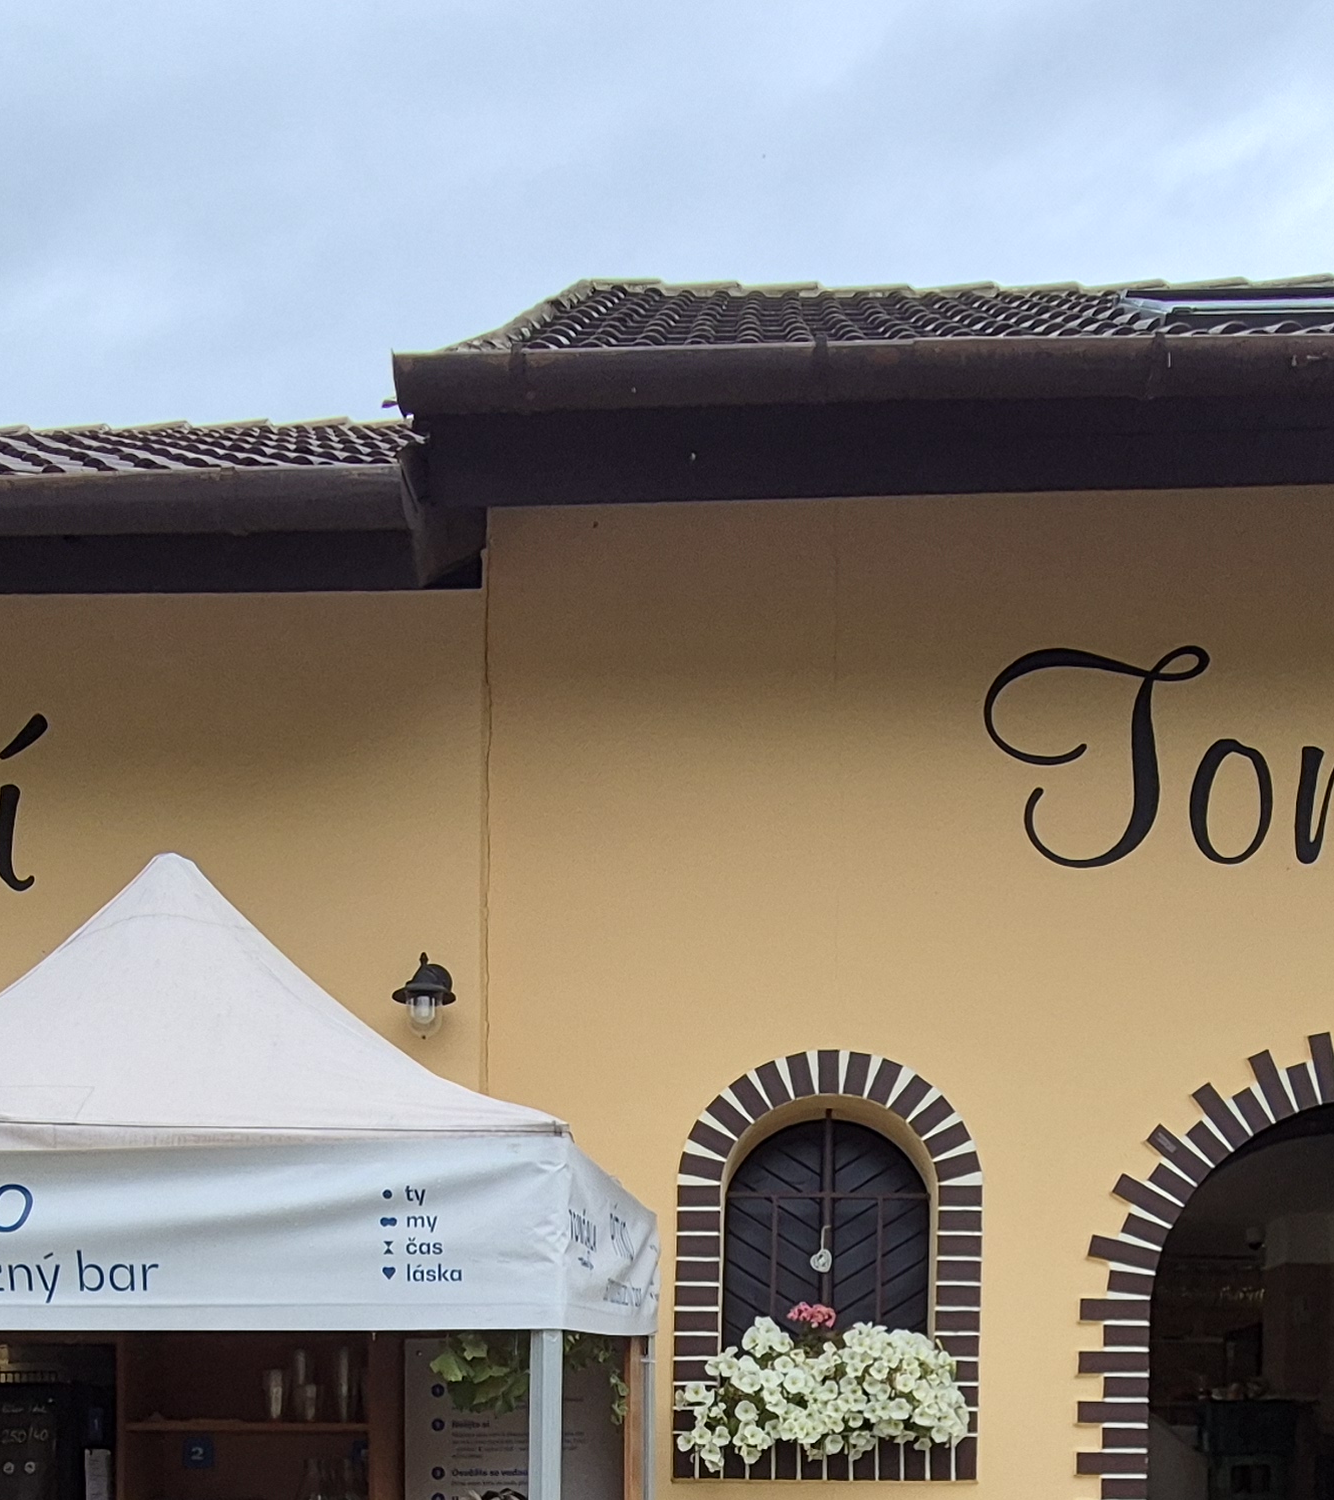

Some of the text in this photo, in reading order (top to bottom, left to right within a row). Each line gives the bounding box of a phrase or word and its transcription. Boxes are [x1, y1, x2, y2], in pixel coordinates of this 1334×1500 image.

[405, 1185, 426, 1206] ty
[406, 1215, 438, 1232] my
[406, 1237, 443, 1255] čas
[76, 1250, 160, 1293] bar
[406, 1264, 463, 1282] láska
[191, 1447, 204, 1460] 2
